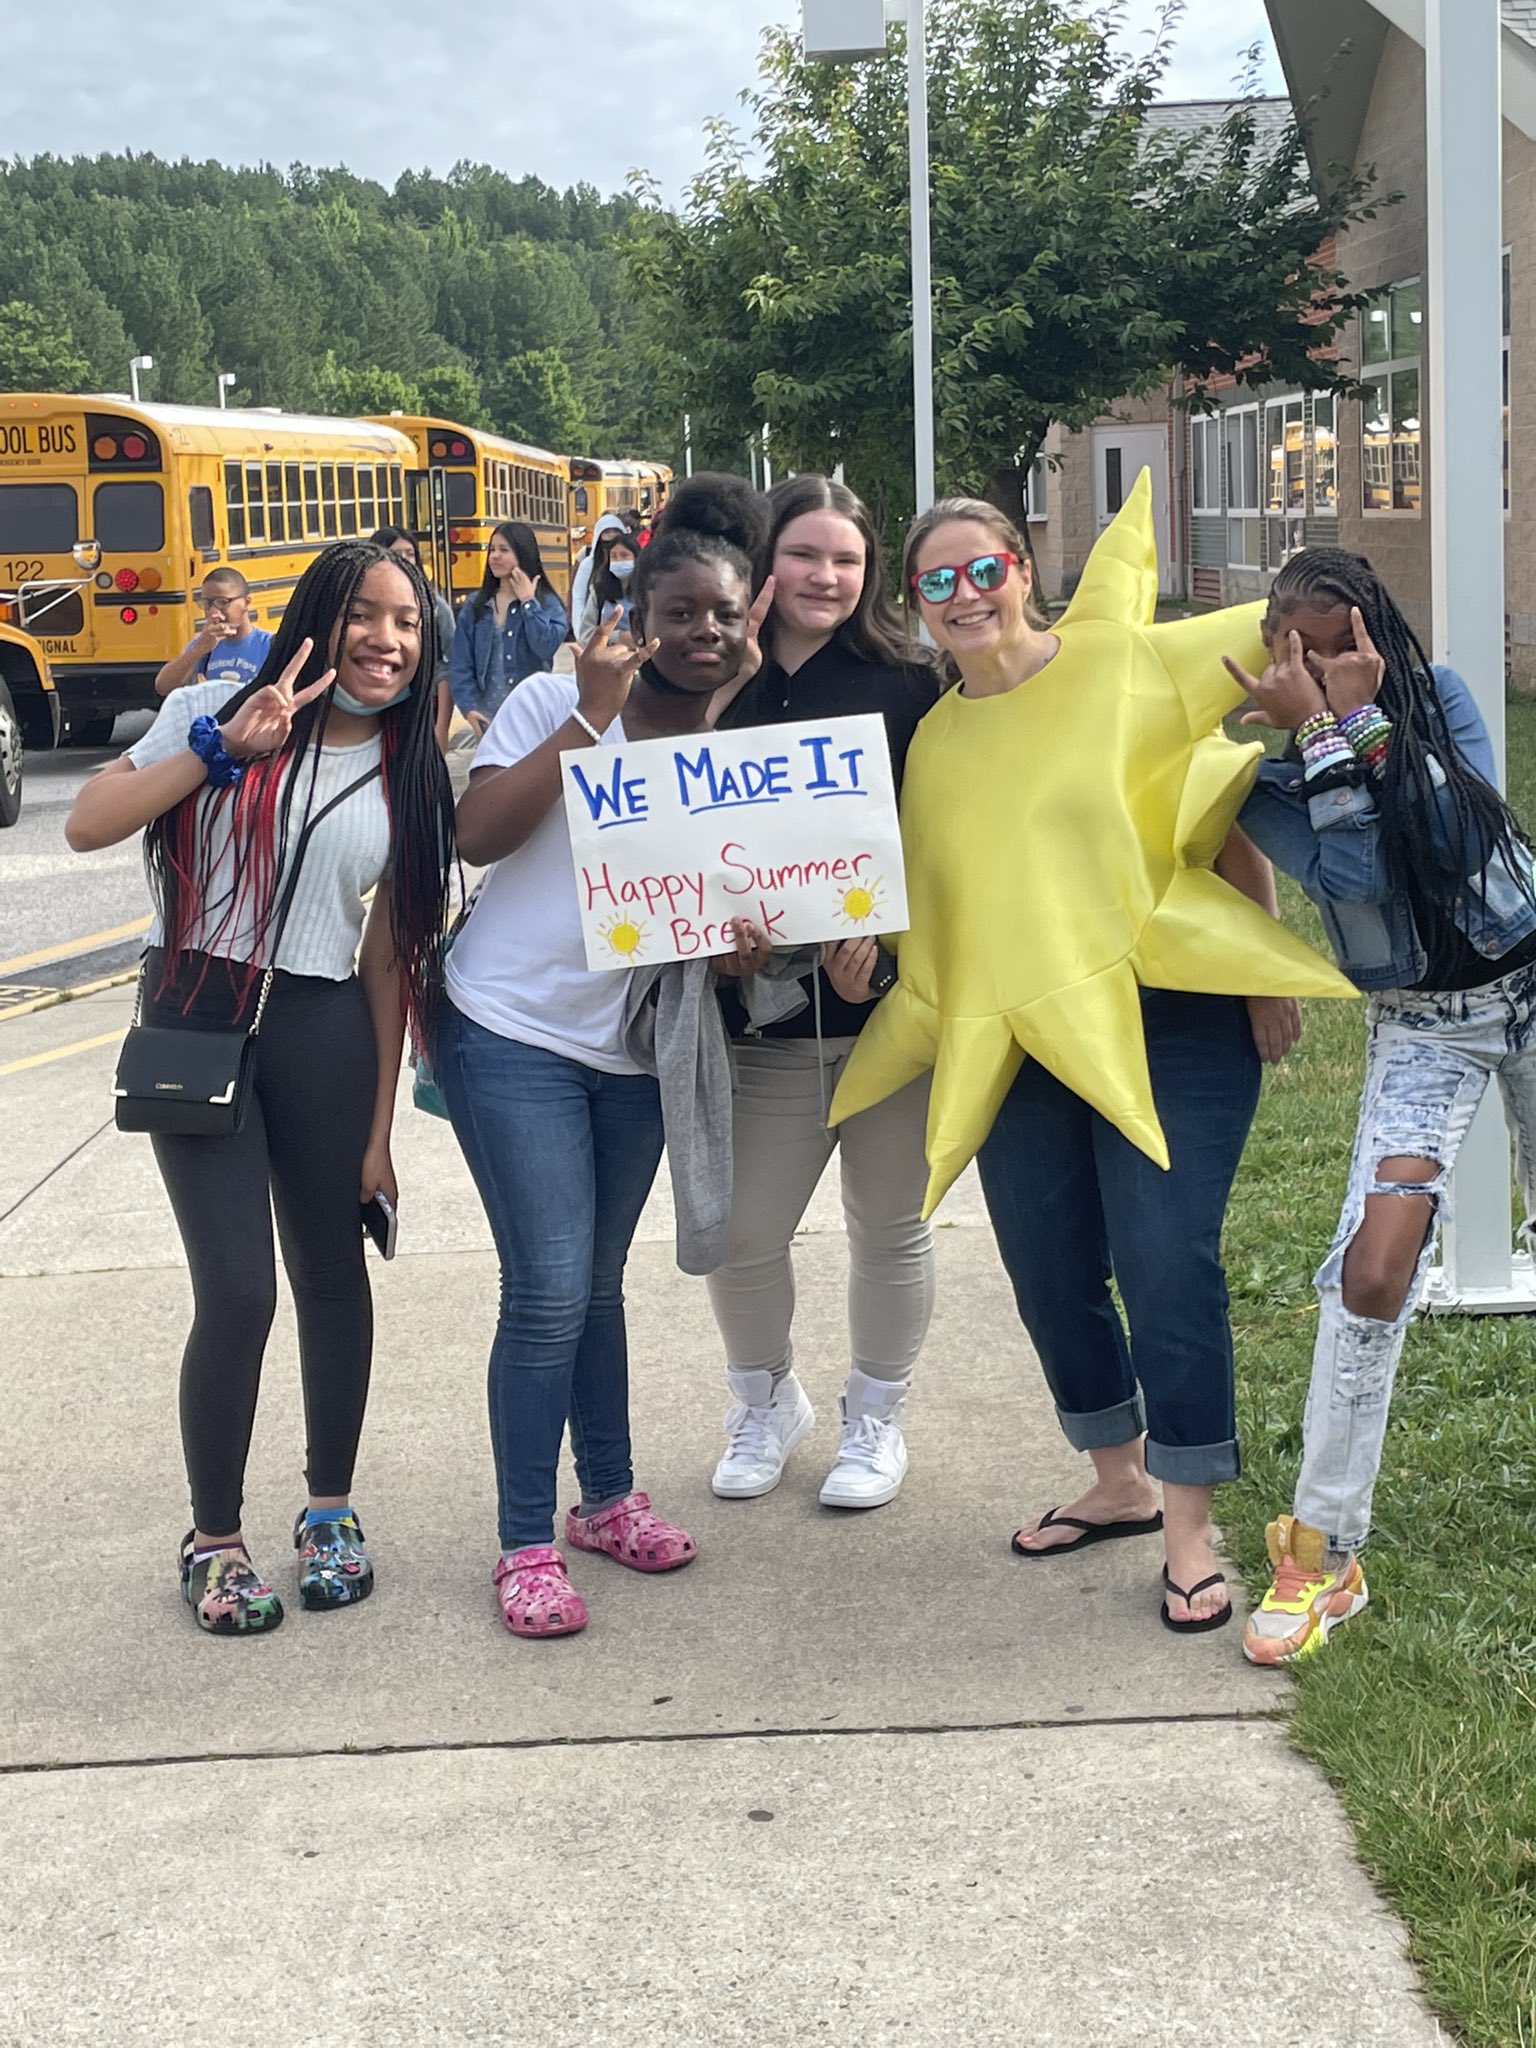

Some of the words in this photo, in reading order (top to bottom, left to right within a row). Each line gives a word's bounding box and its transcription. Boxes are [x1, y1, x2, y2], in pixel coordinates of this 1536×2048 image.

[38, 424, 76, 453] BUS
[4, 561, 44, 581] 122
[570, 757, 649, 821] WE
[674, 747, 792, 806] MADE
[800, 736, 864, 790] IT
[582, 863, 705, 917] Happy
[720, 842, 872, 895] Summer
[670, 900, 787, 955] Brek
